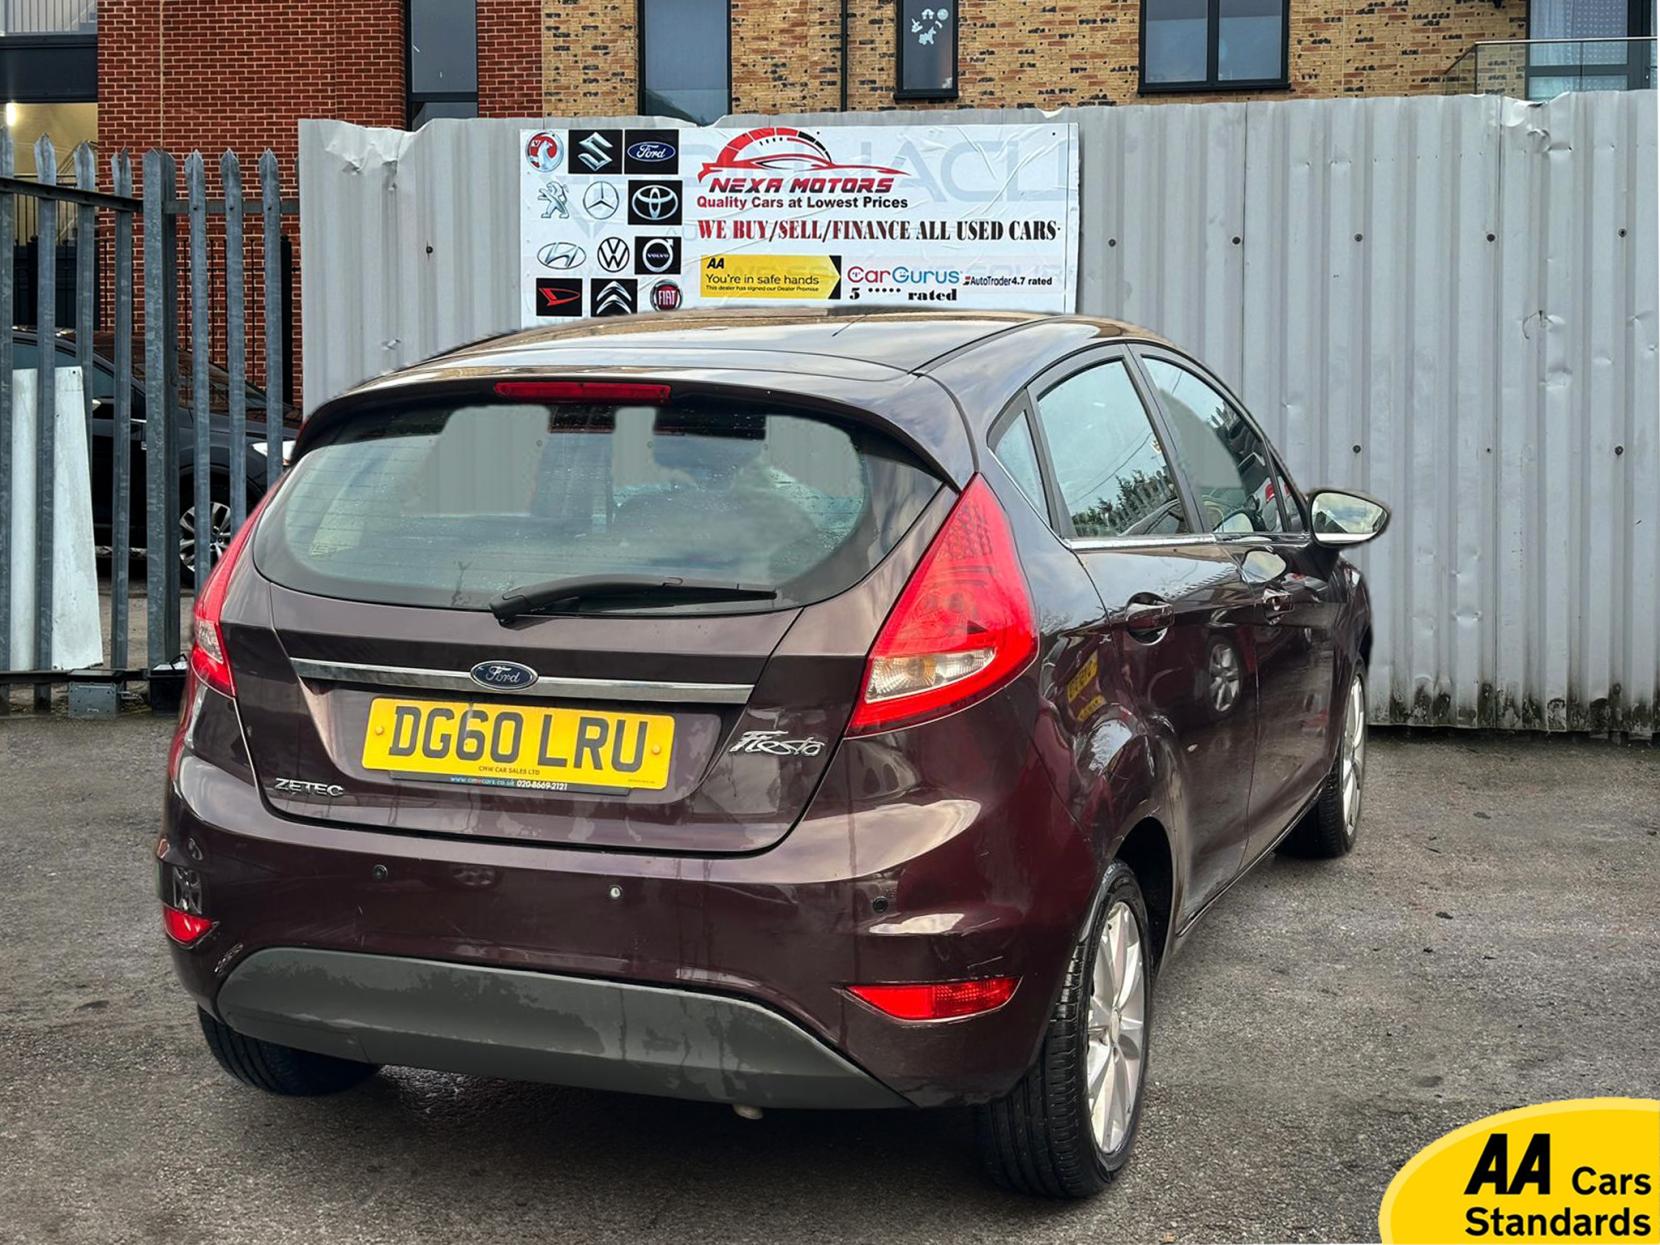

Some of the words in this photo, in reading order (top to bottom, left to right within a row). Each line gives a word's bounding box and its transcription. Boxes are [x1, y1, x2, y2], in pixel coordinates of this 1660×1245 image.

[636, 144, 666, 159] Ford
[709, 178, 784, 193] NEXA
[789, 178, 895, 193] MOTORS
[697, 196, 747, 210] Quality
[752, 196, 783, 208] Cars
[788, 197, 802, 208] at
[807, 196, 858, 208] Lowest
[863, 196, 908, 208] Prices
[697, 220, 726, 239] WE
[916, 221, 950, 240] ALL
[956, 221, 1003, 240] USED
[1009, 221, 1057, 240] CARS
[706, 258, 725, 269] AA
[706, 274, 741, 284] You're
[744, 274, 754, 283] in
[757, 274, 781, 284] safe
[784, 275, 820, 285] hands
[848, 266, 960, 284] CarGurus
[1028, 277, 1052, 285] rated
[658, 290, 677, 305] FIAT
[849, 287, 860, 300] 5
[908, 288, 957, 301] rated
[485, 666, 520, 683] Ford
[388, 706, 524, 763] DG60
[537, 714, 648, 773] LRU
[729, 730, 826, 757] Fiesta
[274, 777, 344, 797] ZETEC
